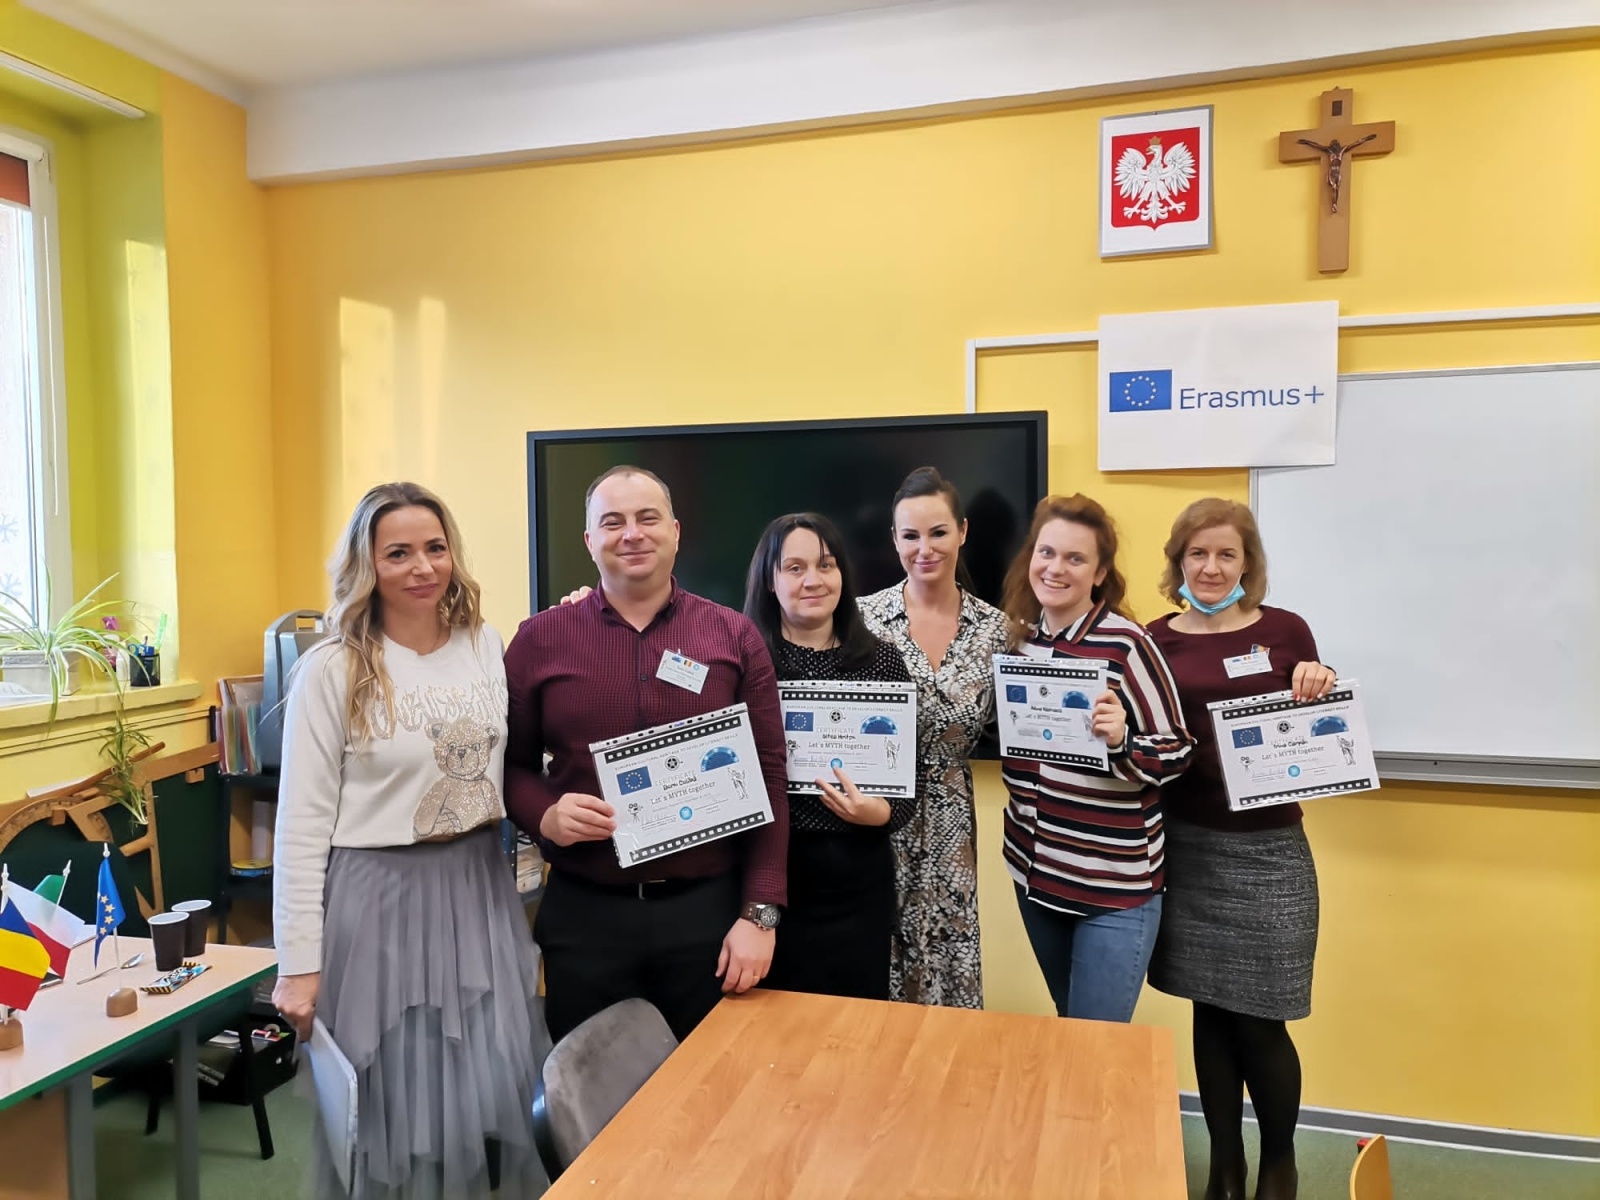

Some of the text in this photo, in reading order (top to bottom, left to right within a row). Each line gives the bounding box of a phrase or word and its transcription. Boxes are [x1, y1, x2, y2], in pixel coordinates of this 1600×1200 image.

[1180, 386, 1324, 409] Erasmus+
[1298, 745, 1324, 754] together
[668, 789, 687, 798] MYTH
[688, 781, 716, 794] together
